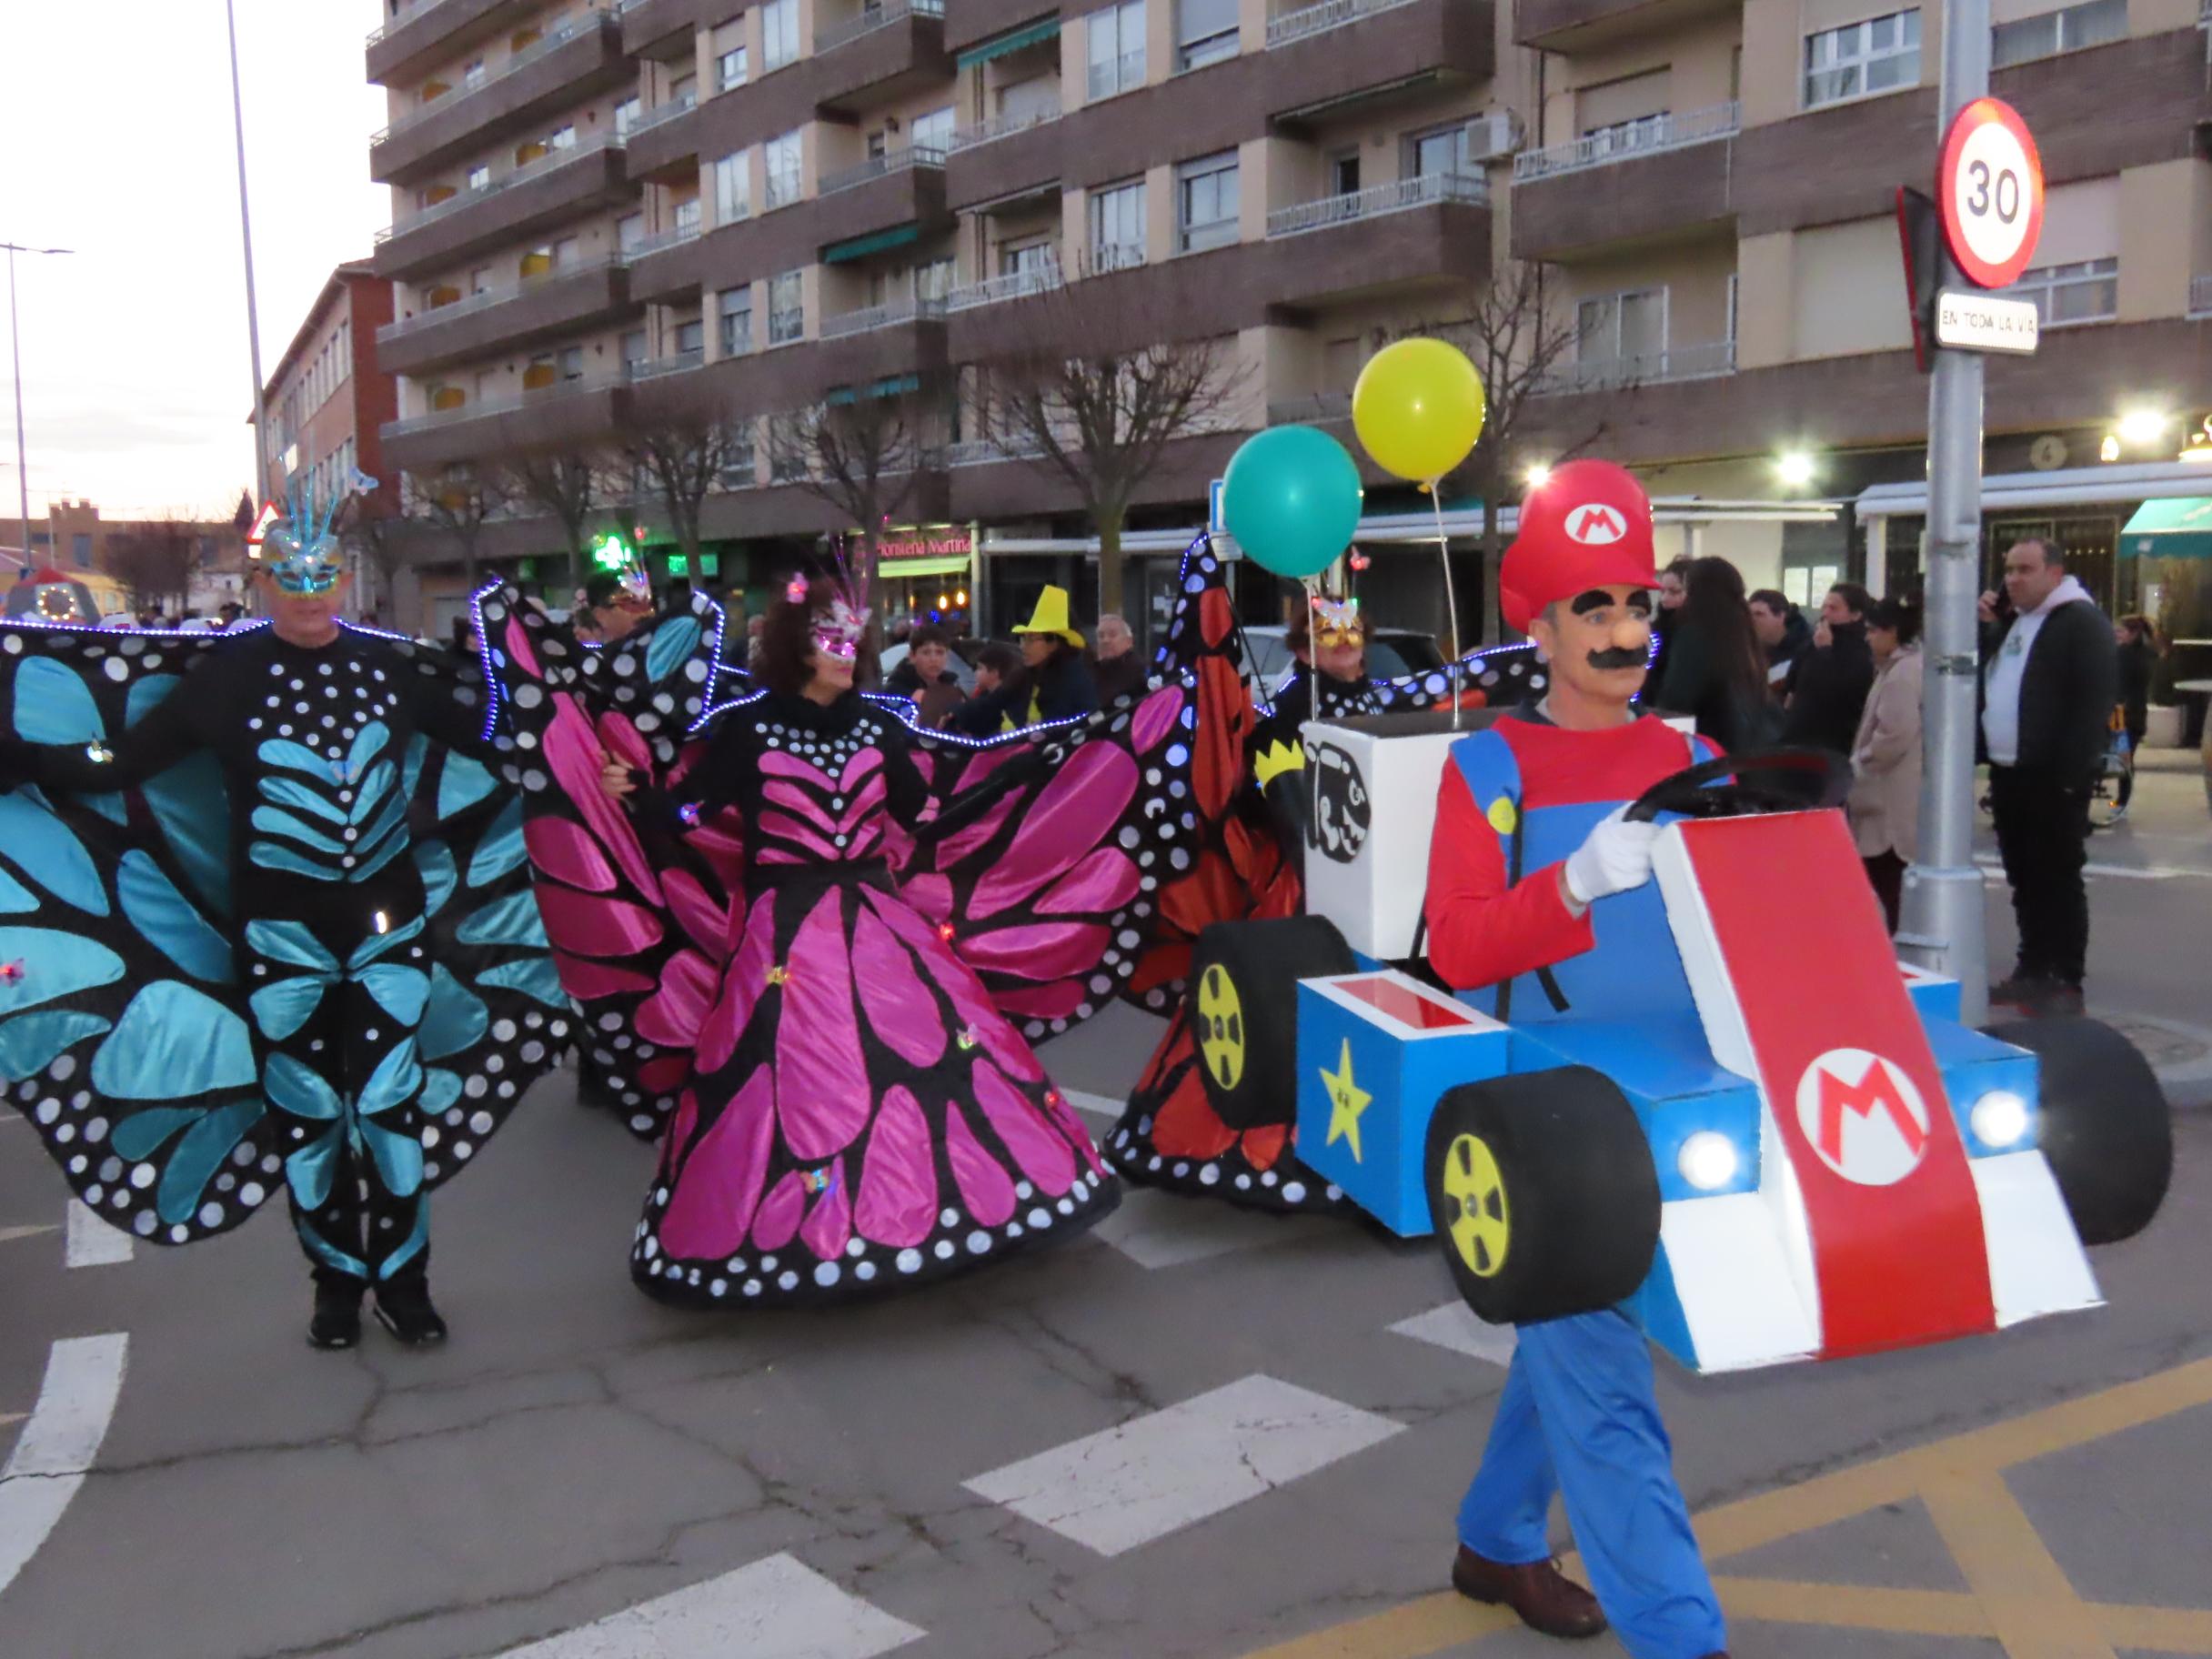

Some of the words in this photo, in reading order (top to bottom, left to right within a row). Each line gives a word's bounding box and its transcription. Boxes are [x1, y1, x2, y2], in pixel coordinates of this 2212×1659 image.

[1967, 159, 2019, 225] 30
[1942, 310, 1958, 326] EN
[1964, 312, 1995, 329] TODA
[2000, 316, 2013, 332] LA
[1576, 508, 1622, 542] M
[1817, 1057, 1926, 1166] M
